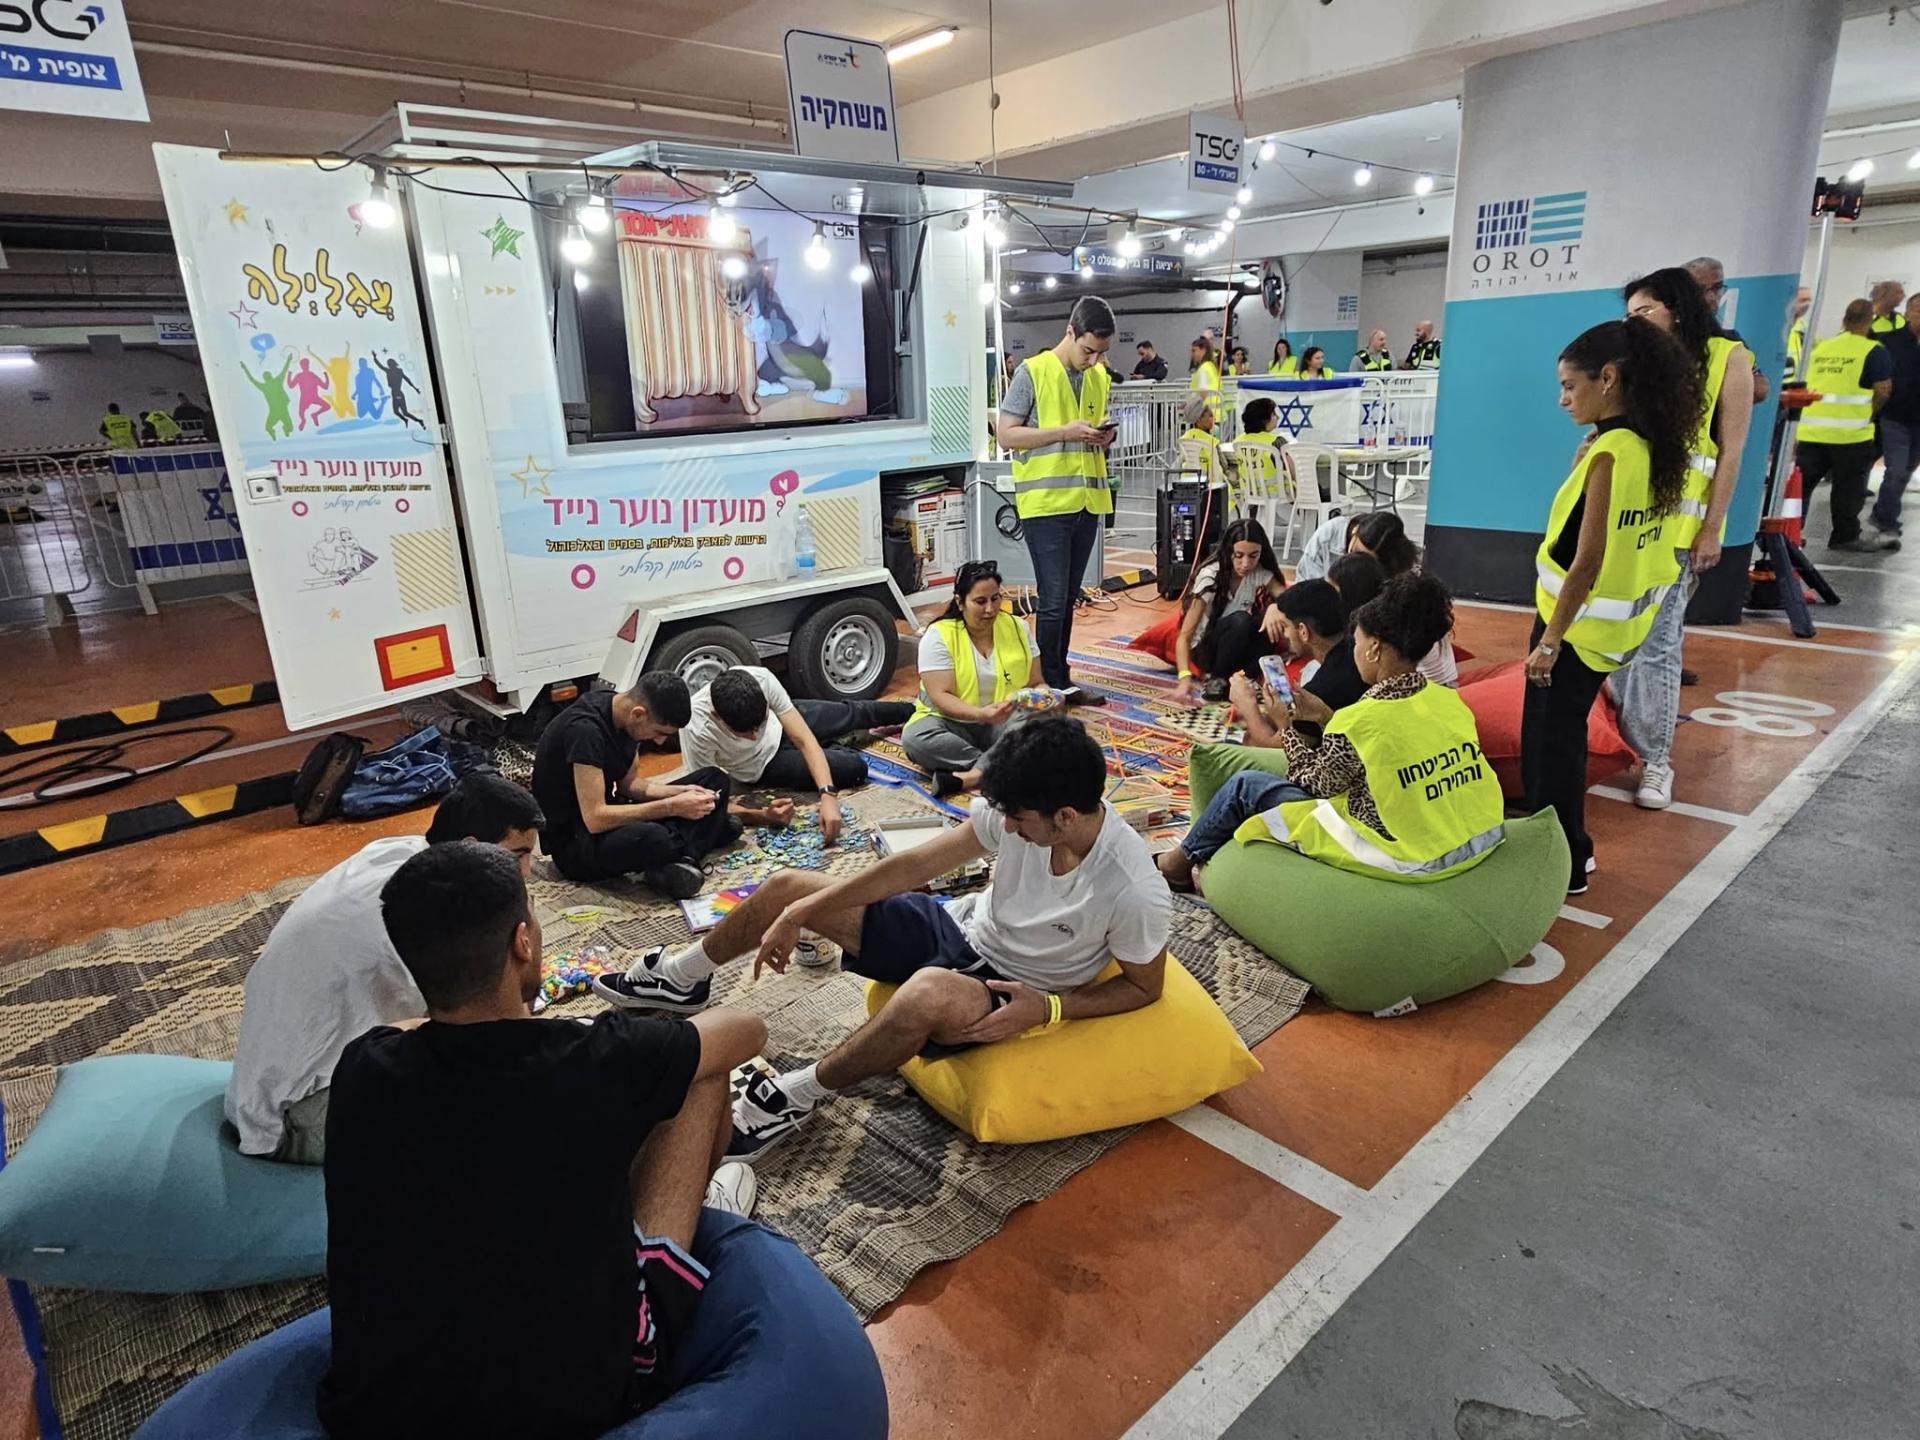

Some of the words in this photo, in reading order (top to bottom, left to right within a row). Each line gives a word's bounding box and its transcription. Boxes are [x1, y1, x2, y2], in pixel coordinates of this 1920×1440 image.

[37, 57, 108, 81] צופית
[799, 95, 888, 131] משחקיה
[1472, 244, 1580, 274] OROT
[1471, 275, 1528, 289] יהודה
[1545, 270, 1579, 283] אור
[270, 459, 309, 477] נייד
[313, 459, 357, 478] נוער
[363, 460, 422, 482] מועדון
[543, 498, 599, 526] נייד
[609, 498, 672, 528] נוער
[682, 498, 767, 533] מועדון
[545, 538, 606, 553] ובאלכוהול
[608, 538, 644, 550] בסמים
[646, 534, 694, 550] באלימות,
[697, 533, 732, 549] למאבק
[734, 534, 767, 546] הרשות
[618, 552, 664, 581] קהילתי
[1689, 690, 1836, 738] 80
[1397, 747, 1461, 789] הביטחון
[1424, 763, 1483, 801] והחירום
